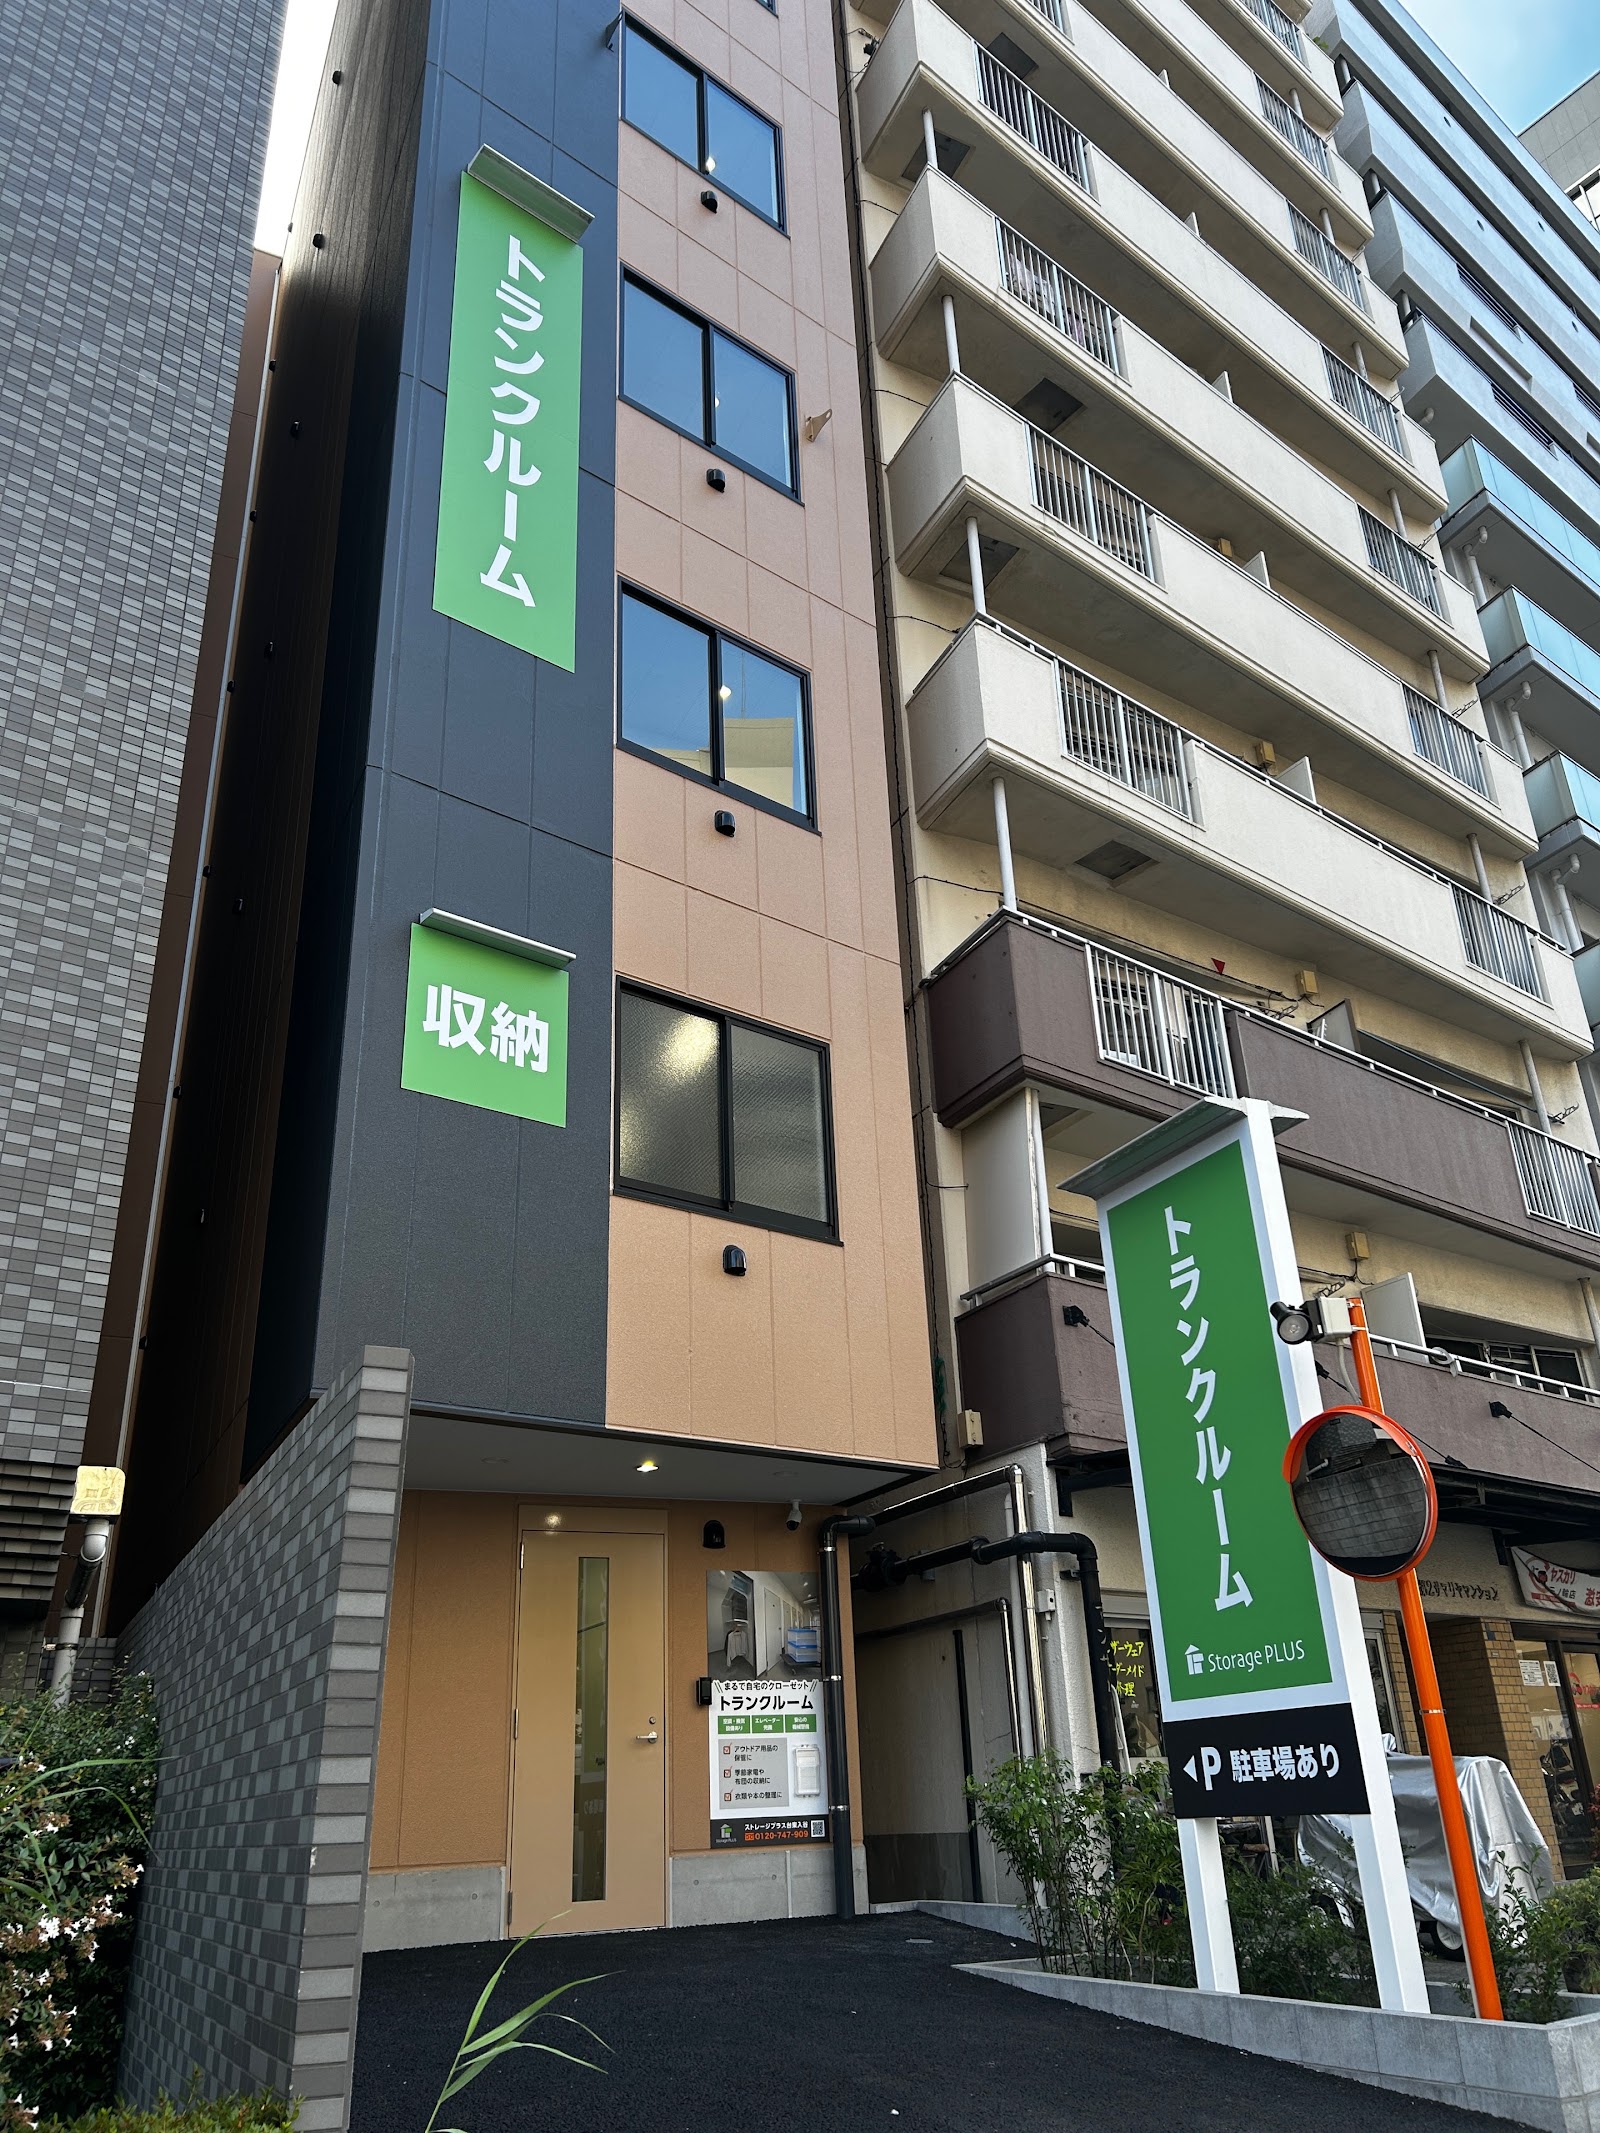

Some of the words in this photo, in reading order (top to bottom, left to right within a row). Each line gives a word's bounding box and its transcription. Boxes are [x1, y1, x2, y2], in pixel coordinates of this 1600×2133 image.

[479, 234, 546, 607] トランクルーム
[422, 983, 549, 1073] 収納
[1164, 1205, 1254, 1612] トランクルーム
[1207, 1650, 1262, 1673] Storage
[1264, 1639, 1305, 1664] PLUS
[720, 1695, 814, 1711] トランクルーム
[724, 1681, 809, 1691] まるで自宅のクローゼット
[734, 1745, 779, 1753] アウトドア用品の
[1229, 1743, 1340, 1783] 駐車場あり
[1200, 1746, 1222, 1791] P
[755, 1831, 809, 1840] 0120-747-909
